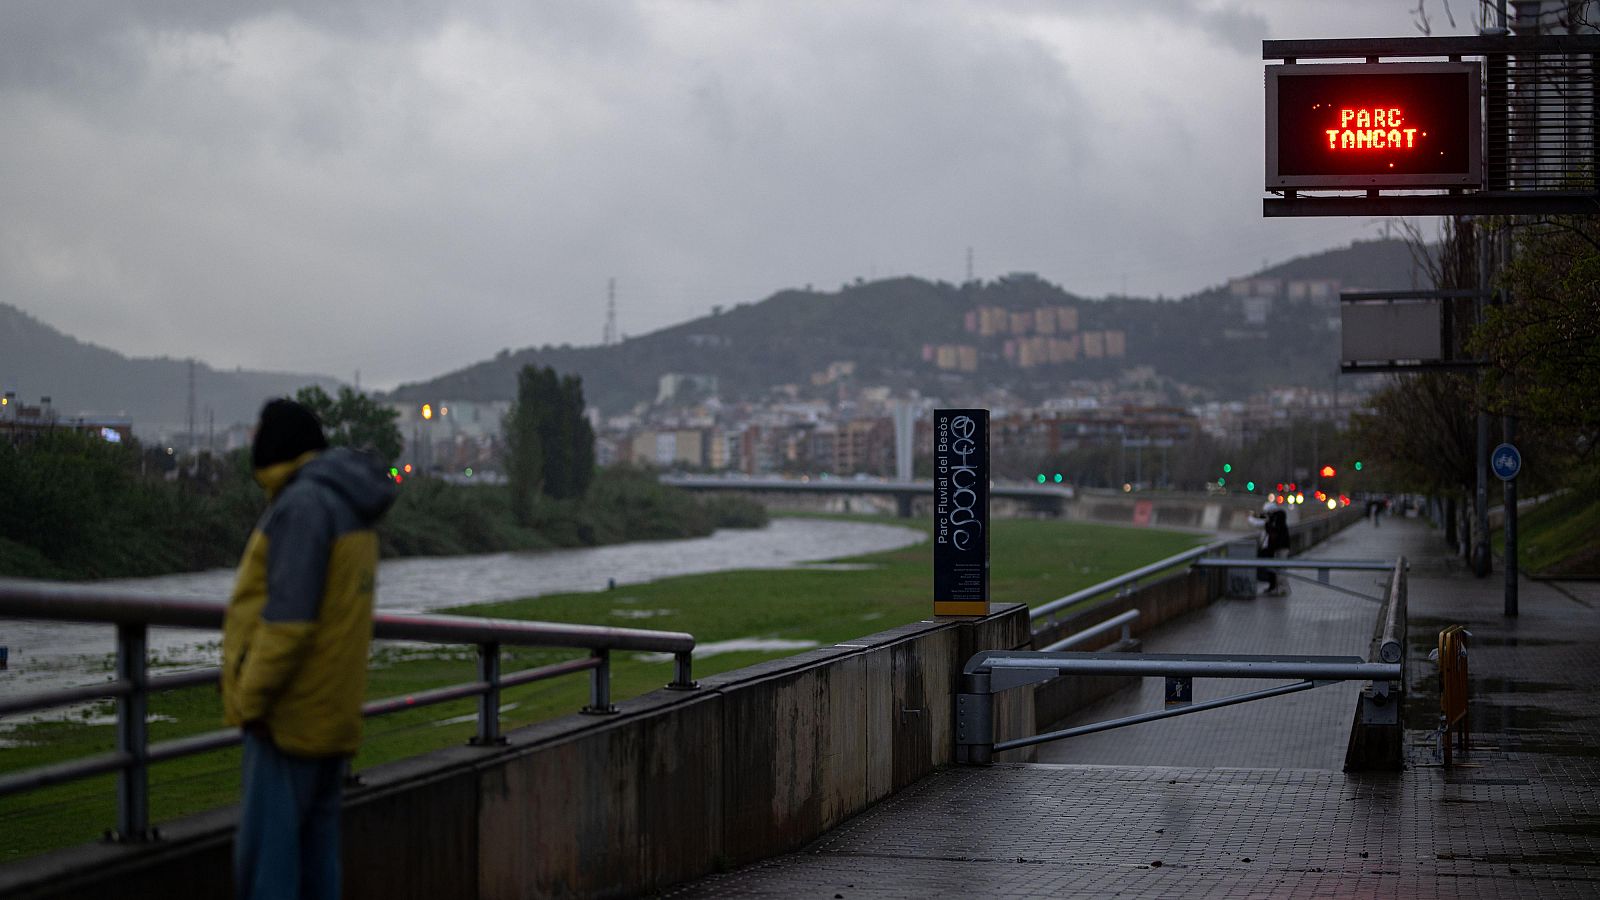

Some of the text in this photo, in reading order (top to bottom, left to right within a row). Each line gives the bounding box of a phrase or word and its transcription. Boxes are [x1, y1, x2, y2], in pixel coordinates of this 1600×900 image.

[1341, 109, 1401, 128] PARC
[1326, 128, 1417, 149] TANCAT
[938, 416, 948, 544] Parc Fluvial del Besòs
